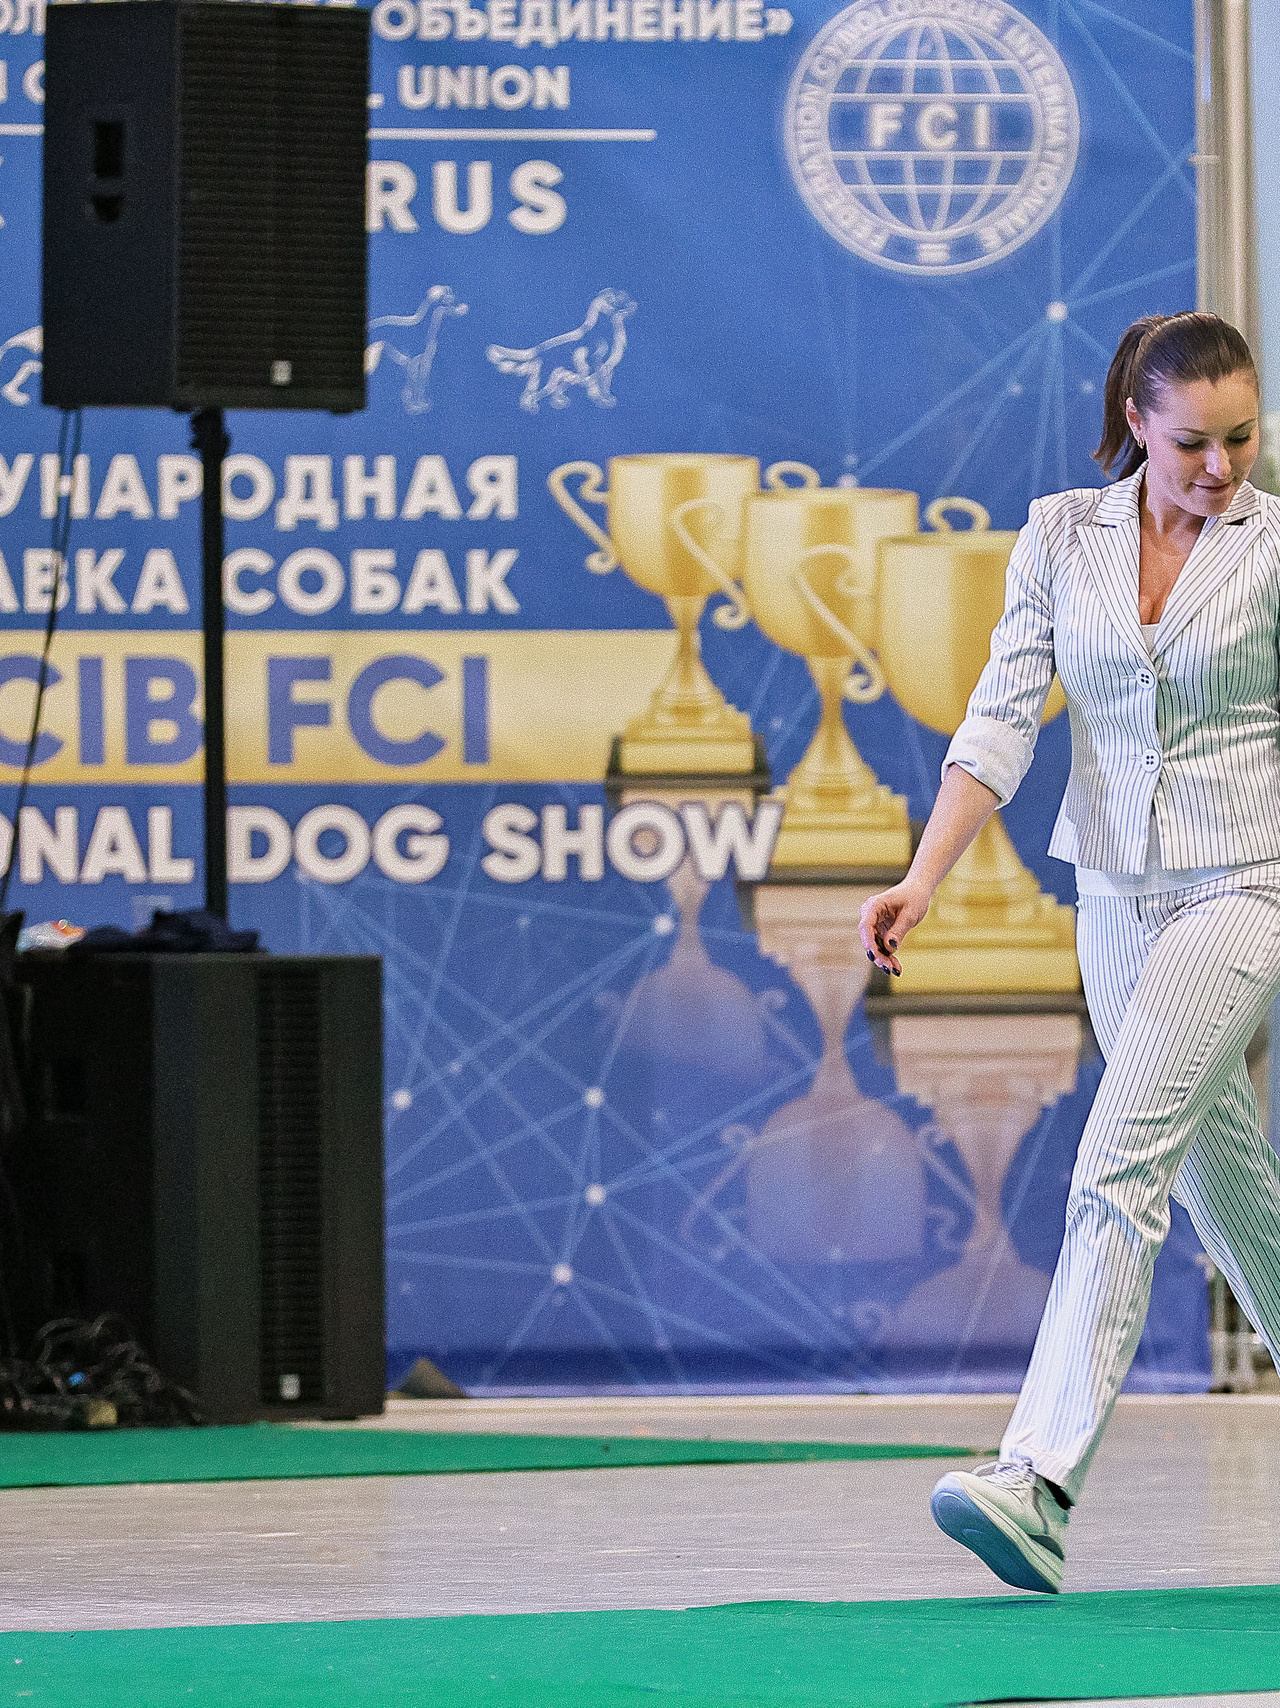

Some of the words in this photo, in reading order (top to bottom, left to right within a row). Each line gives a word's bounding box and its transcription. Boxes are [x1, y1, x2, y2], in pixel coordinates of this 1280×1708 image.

[397, 64, 572, 111] UNION
[866, 103, 991, 149] FCI
[221, 547, 519, 615] СОБАК
[266, 653, 491, 768] FCI
[0, 804, 195, 884] NAL
[226, 804, 449, 884] DOG
[481, 801, 784, 884] SHOW
